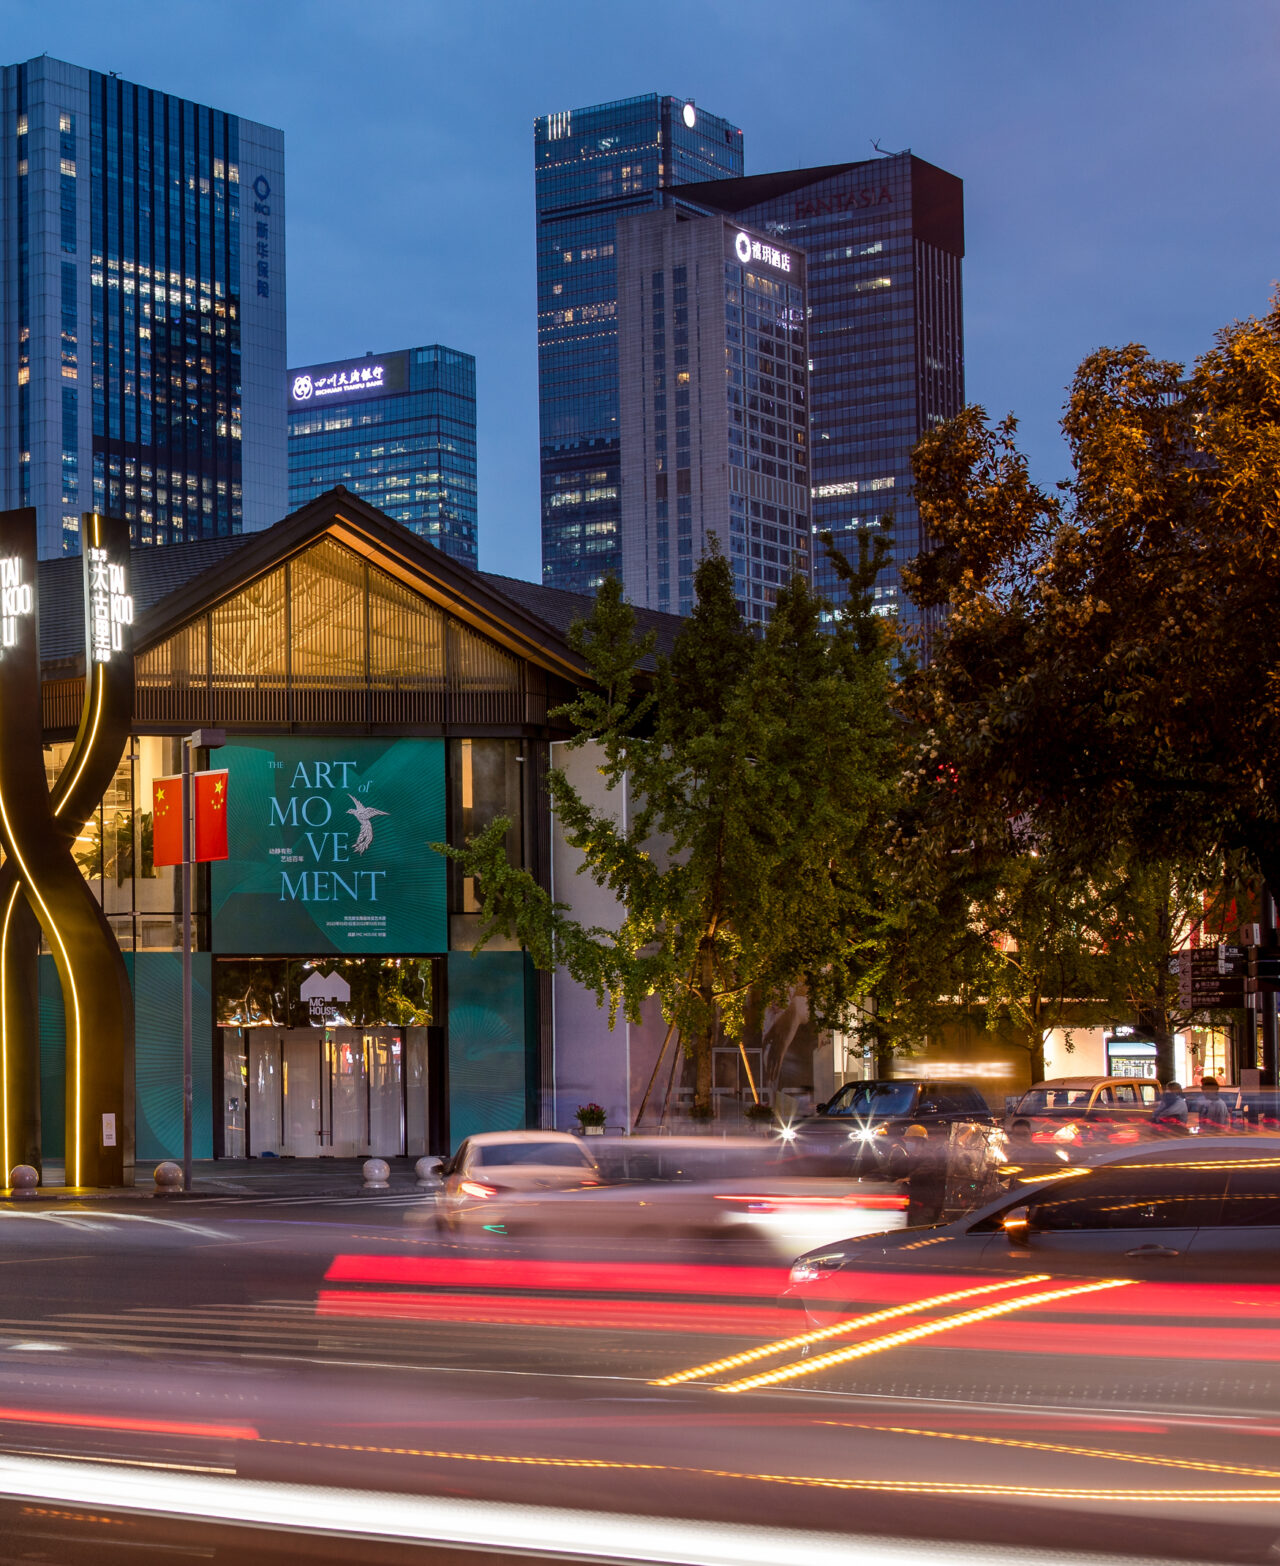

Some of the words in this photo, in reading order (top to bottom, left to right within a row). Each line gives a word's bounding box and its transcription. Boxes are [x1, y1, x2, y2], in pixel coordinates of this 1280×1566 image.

[795, 185, 893, 220] FANTASIA
[256, 221, 269, 298] 新华保险
[315, 386, 342, 396] SICHUAN
[343, 382, 365, 391] TIANFU
[366, 380, 383, 388] BANK
[108, 563, 125, 595] TAI
[1, 584, 32, 616] KOO
[92, 562, 110, 650] 太古里
[110, 593, 134, 625] KOO
[268, 761, 284, 769] THE
[289, 761, 357, 788] ART
[358, 780, 373, 793] of
[269, 796, 332, 827] MO
[305, 832, 349, 862] VE
[280, 871, 386, 900] MENT
[309, 998, 324, 1007] MC
[309, 1006, 337, 1016] HOUSE
